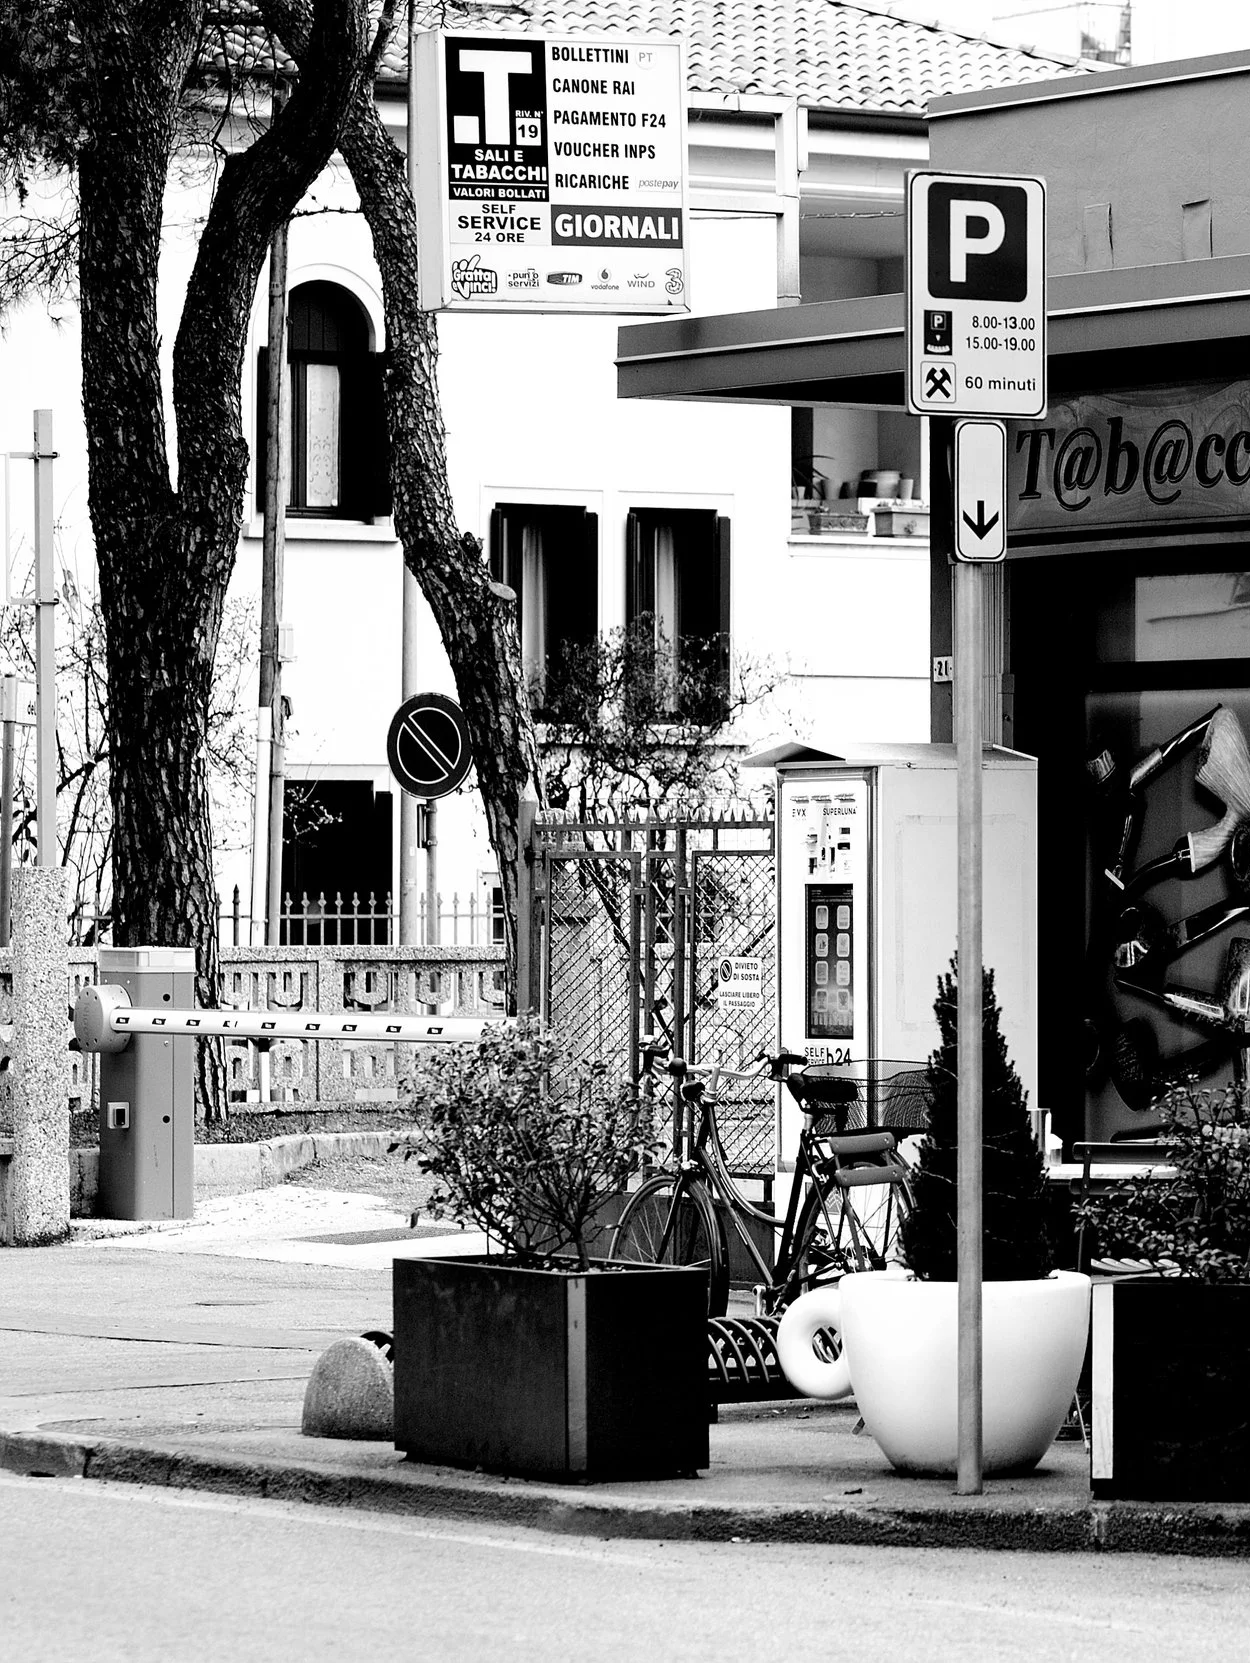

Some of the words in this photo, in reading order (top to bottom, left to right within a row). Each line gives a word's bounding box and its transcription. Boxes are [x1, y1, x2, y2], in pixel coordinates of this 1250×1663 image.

[551, 46, 629, 64] BOLLETTINI
[638, 52, 653, 63] PT
[553, 78, 608, 95] CANONE
[613, 81, 636, 96] RAI
[515, 110, 532, 118] RIV.
[553, 110, 637, 128] PAGAMENTO
[641, 113, 667, 128] F24
[517, 124, 539, 138] 19
[474, 149, 509, 162] SALI
[514, 151, 524, 162] E
[554, 141, 620, 159] VOUCHER
[624, 144, 656, 160] INPS
[450, 164, 547, 182] TABACCHI
[555, 173, 630, 190] RICARICHE
[638, 178, 679, 190] postepay
[453, 187, 495, 198] VALORI
[498, 188, 546, 199] BOLLATI
[481, 203, 516, 215] SELF
[457, 216, 541, 231] SERVICE
[554, 212, 680, 240] GIORNALI
[474, 231, 493, 243] 24
[496, 232, 525, 243] ORE
[949, 199, 1006, 283] P
[453, 268, 492, 282] Gratta
[562, 274, 581, 284] TIM
[664, 267, 684, 295] 3
[507, 279, 539, 288] servizi
[590, 283, 620, 291] vodafone
[627, 280, 656, 289] WIND
[971, 315, 1036, 331] 8.00-13.00
[965, 336, 1036, 352] 15.00-19.00
[964, 376, 983, 390] 60
[988, 377, 1036, 391] minuti
[822, 807, 857, 816] SUPERLUNA
[735, 962, 759, 970] DIVIETO
[733, 972, 740, 980] DI
[741, 973, 760, 981] SOSTA
[804, 1046, 825, 1057] SELF
[826, 1047, 851, 1067] h24
